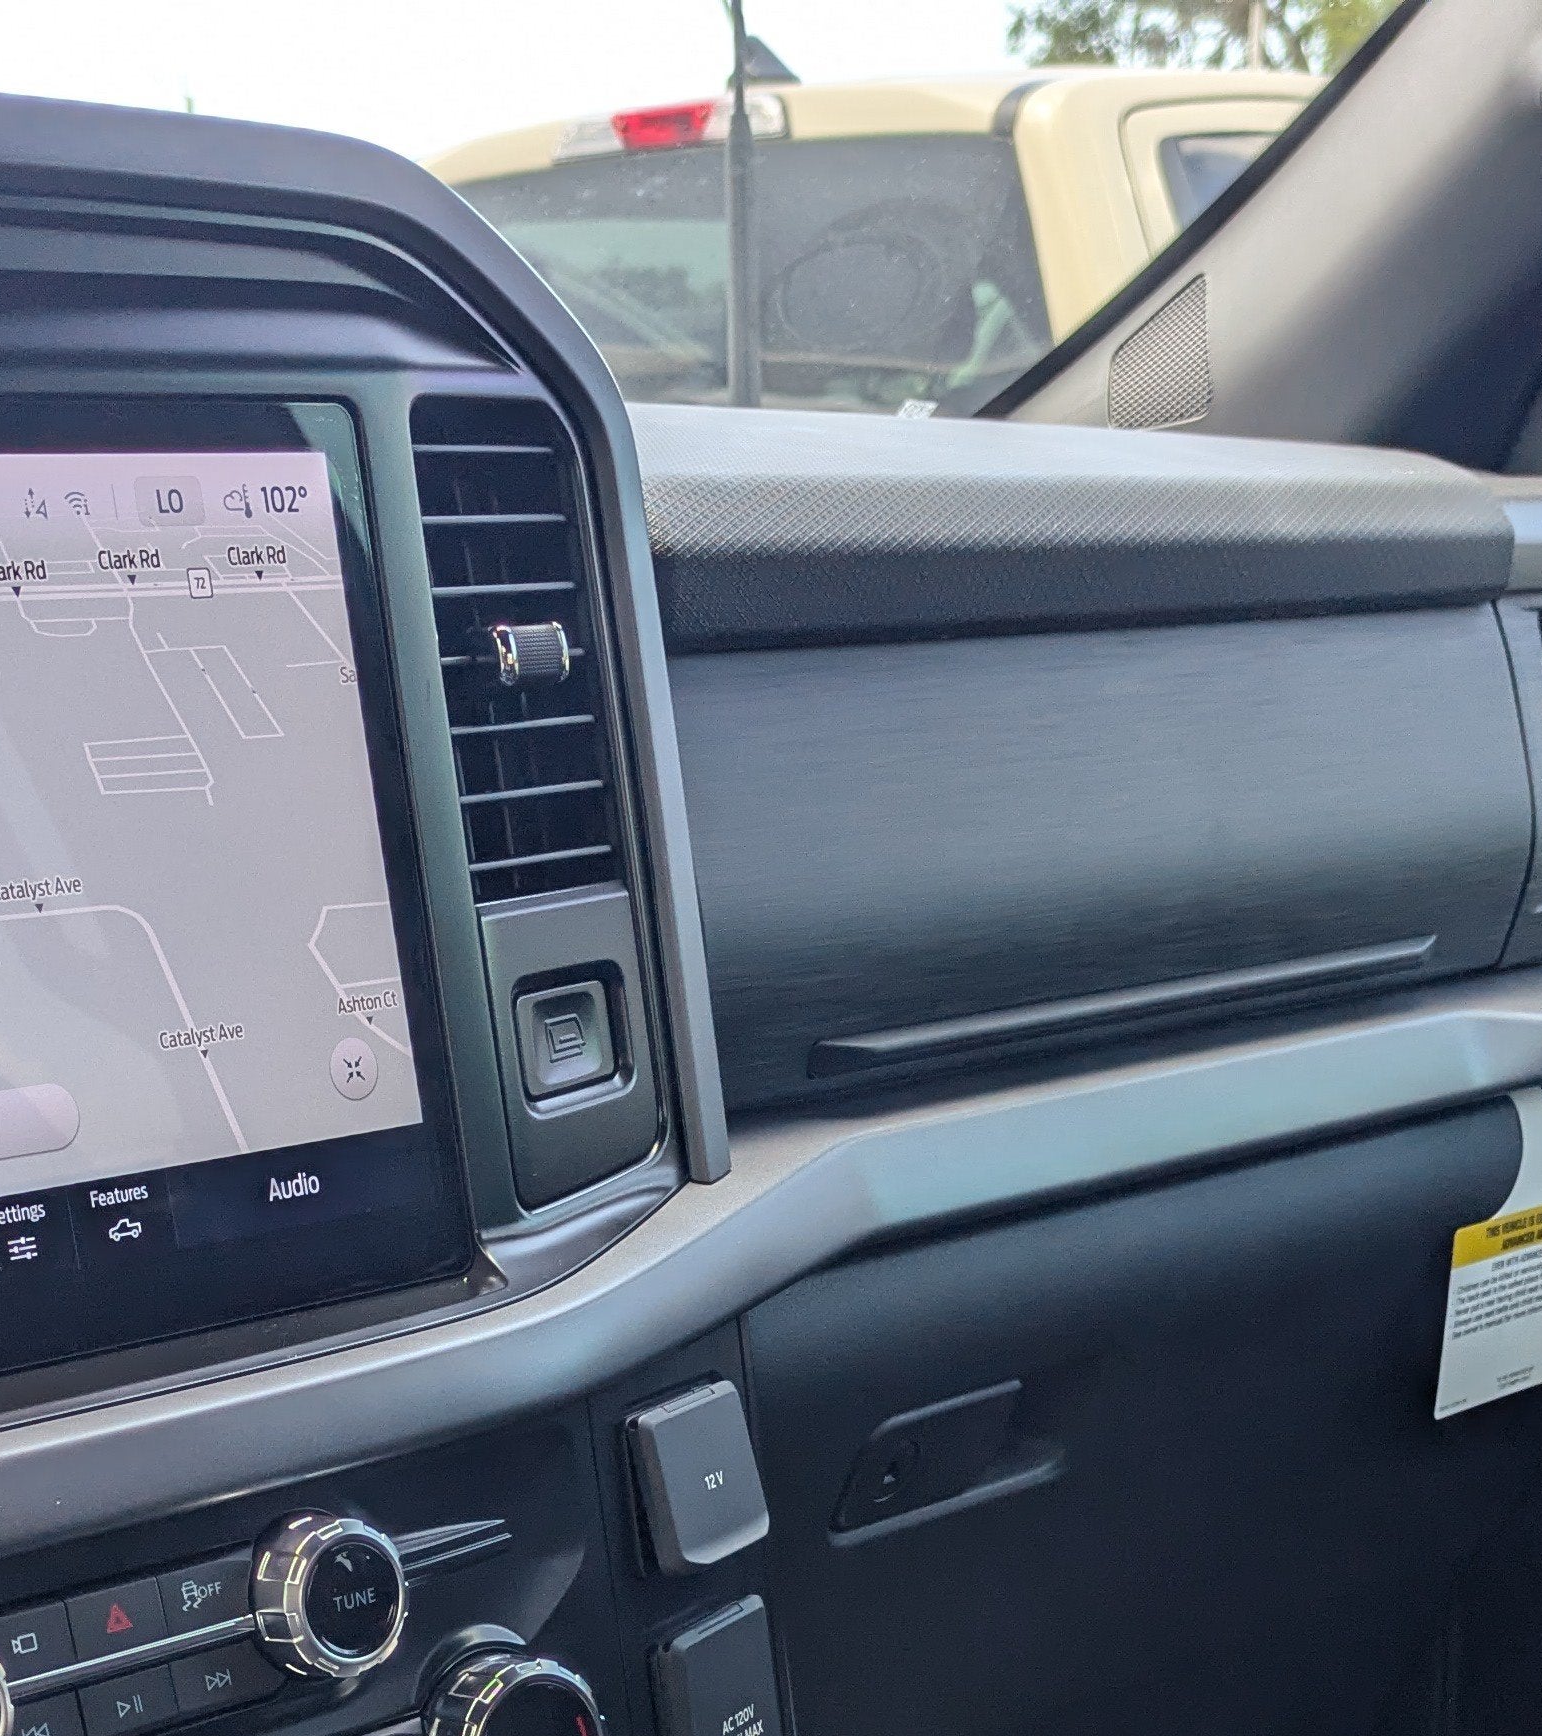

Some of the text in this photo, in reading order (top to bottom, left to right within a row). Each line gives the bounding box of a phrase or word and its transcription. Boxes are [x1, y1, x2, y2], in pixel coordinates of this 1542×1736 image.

[154, 488, 184, 515] LO
[260, 484, 308, 514] 102°
[96, 548, 161, 570] Clark Rd
[226, 546, 287, 567] Clark Rd
[23, 560, 47, 582] Rd
[194, 576, 207, 591] 72
[54, 875, 83, 897] Ave
[337, 990, 398, 1015] Ashton Ct
[158, 1021, 244, 1050] Catalyst Ave
[89, 1183, 149, 1210] Features
[268, 1172, 321, 1202] Audio
[197, 1580, 223, 1599] OFF
[332, 1587, 377, 1613] TUNE
[722, 1703, 755, 1736] AC 120V
